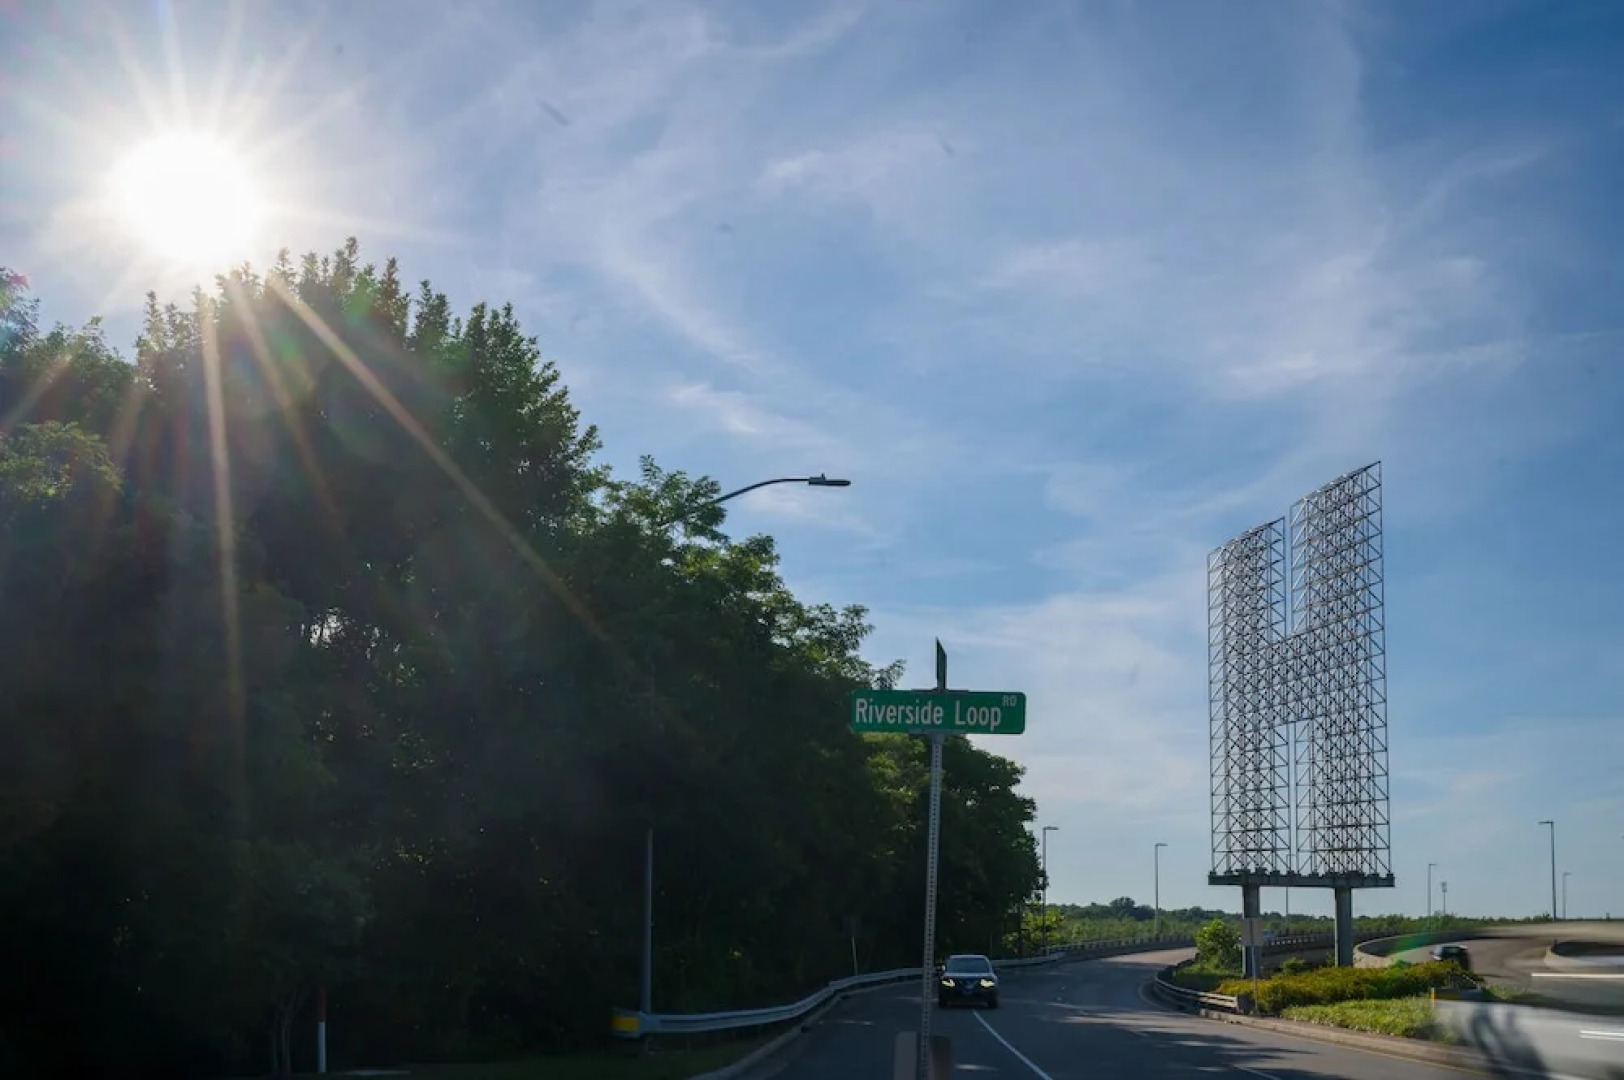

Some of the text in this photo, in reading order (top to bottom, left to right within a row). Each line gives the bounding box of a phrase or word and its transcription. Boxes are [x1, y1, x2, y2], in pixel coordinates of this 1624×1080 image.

[855, 695, 1017, 731] Riverside Loop RD
